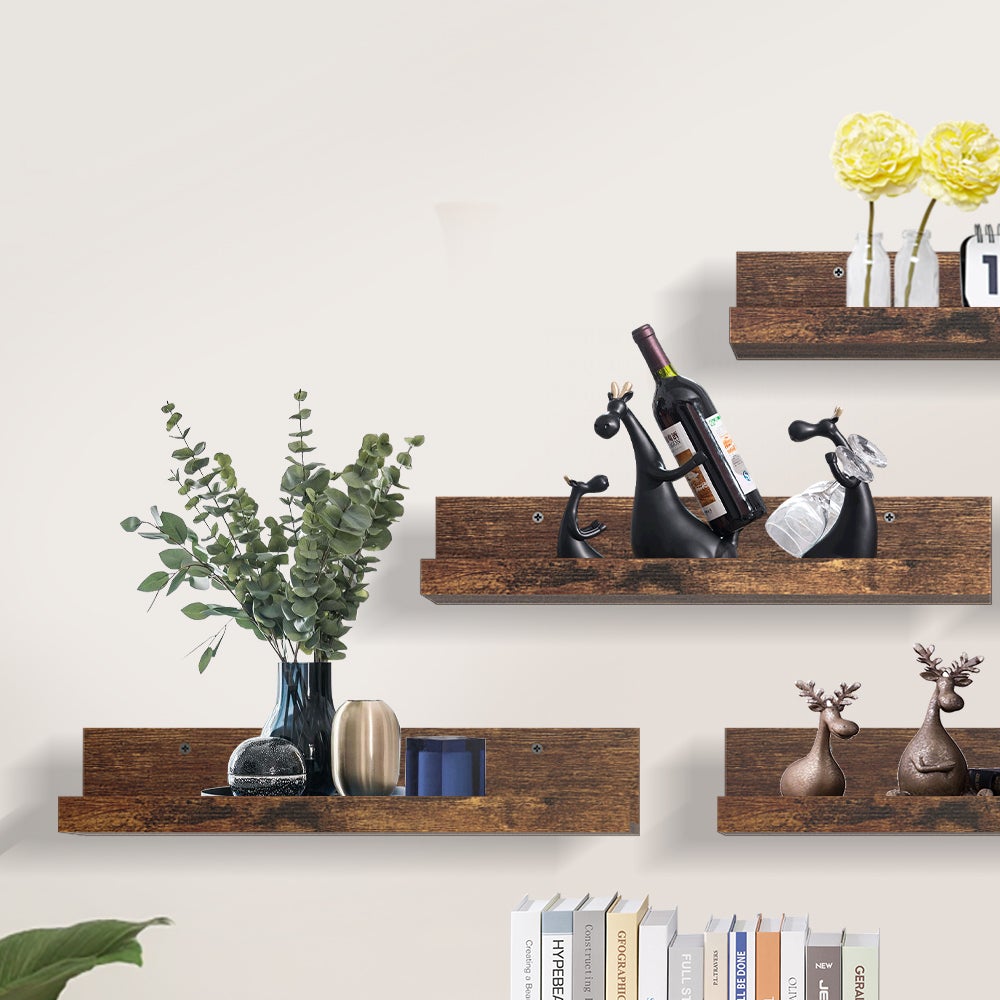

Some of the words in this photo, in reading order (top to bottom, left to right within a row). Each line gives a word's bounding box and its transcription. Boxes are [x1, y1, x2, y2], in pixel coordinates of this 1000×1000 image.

[524, 940, 534, 974] Creating
[583, 924, 594, 993] Constructing
[681, 953, 692, 984] FULL
[736, 951, 746, 977] DONE
[815, 962, 833, 970] NEW
[736, 978, 746, 989] BE
